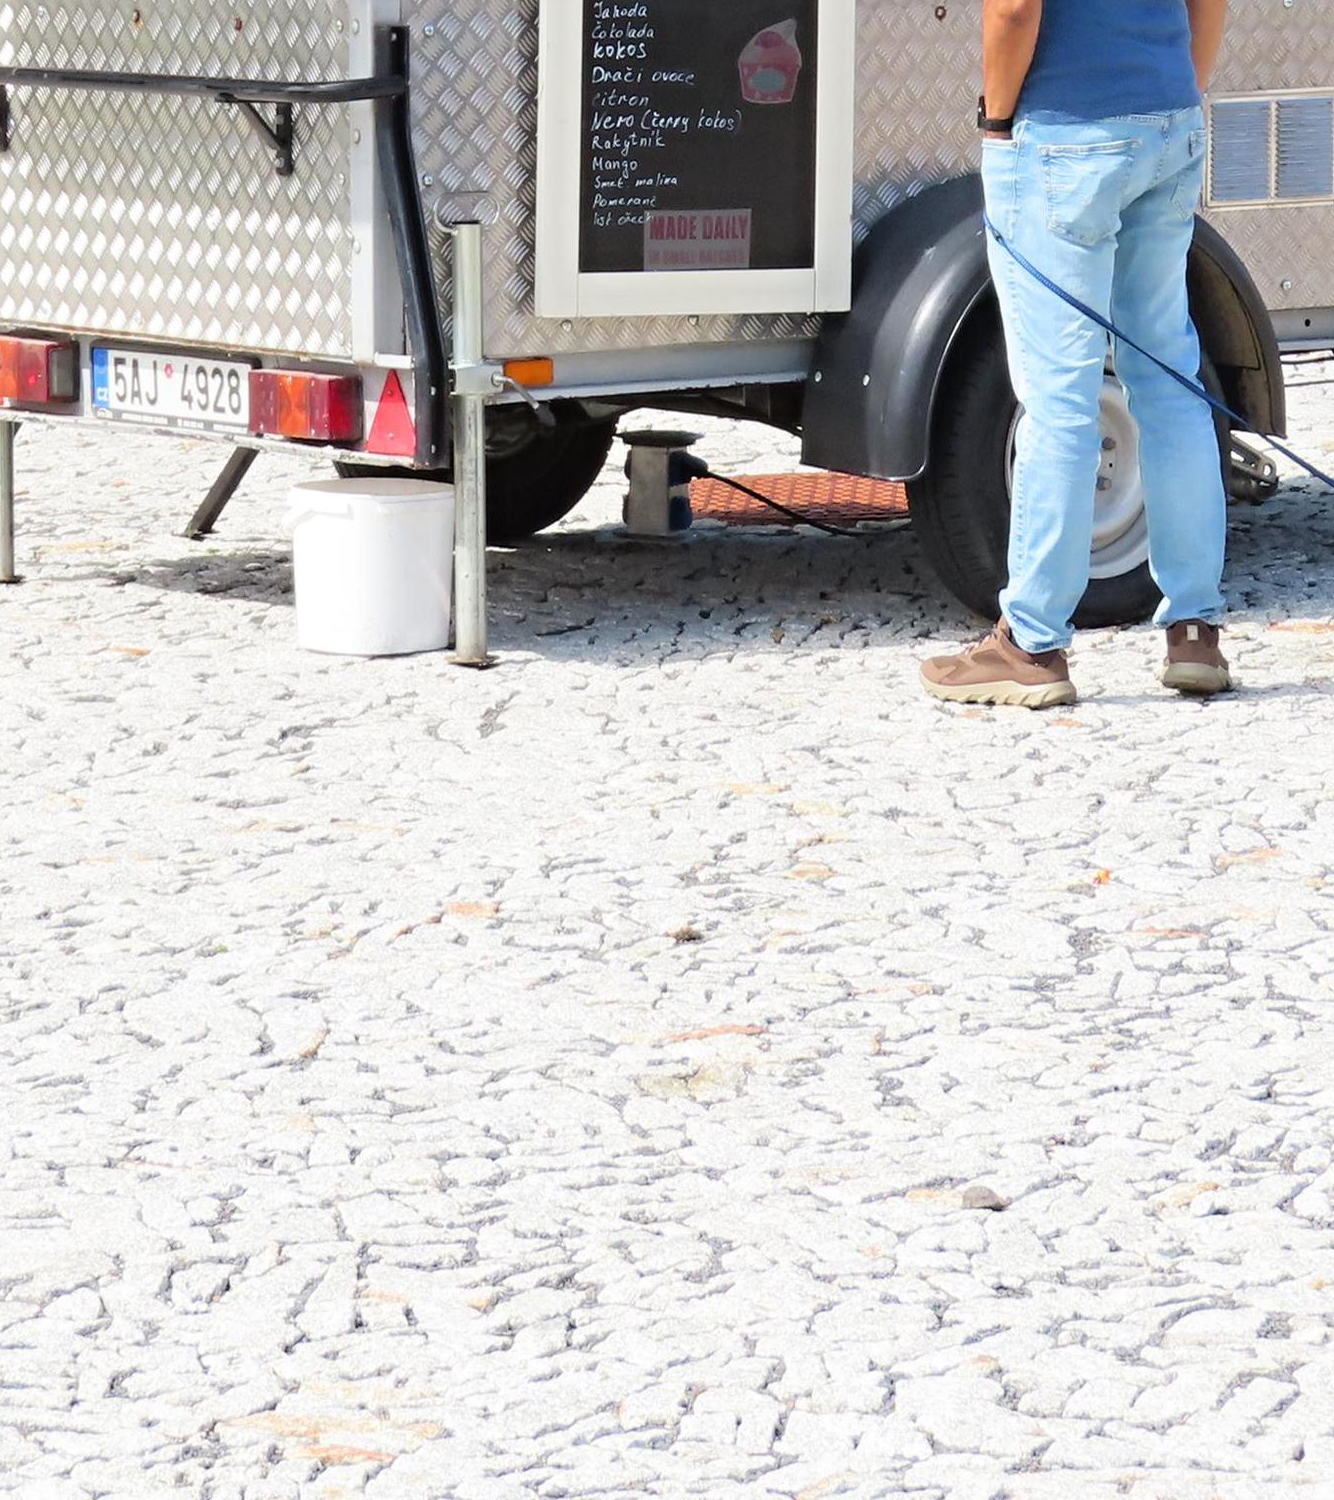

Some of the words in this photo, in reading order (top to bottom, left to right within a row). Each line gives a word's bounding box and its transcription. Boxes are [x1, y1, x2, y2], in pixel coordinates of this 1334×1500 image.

[594, 2, 648, 19] Jahoda
[652, 69, 695, 85] ovoce
[590, 112, 634, 131] Nero
[592, 157, 638, 178] Mango
[650, 215, 697, 240] MADE
[703, 214, 748, 240] DAILY
[114, 357, 158, 406] 5AJ
[181, 364, 242, 414] 4928
